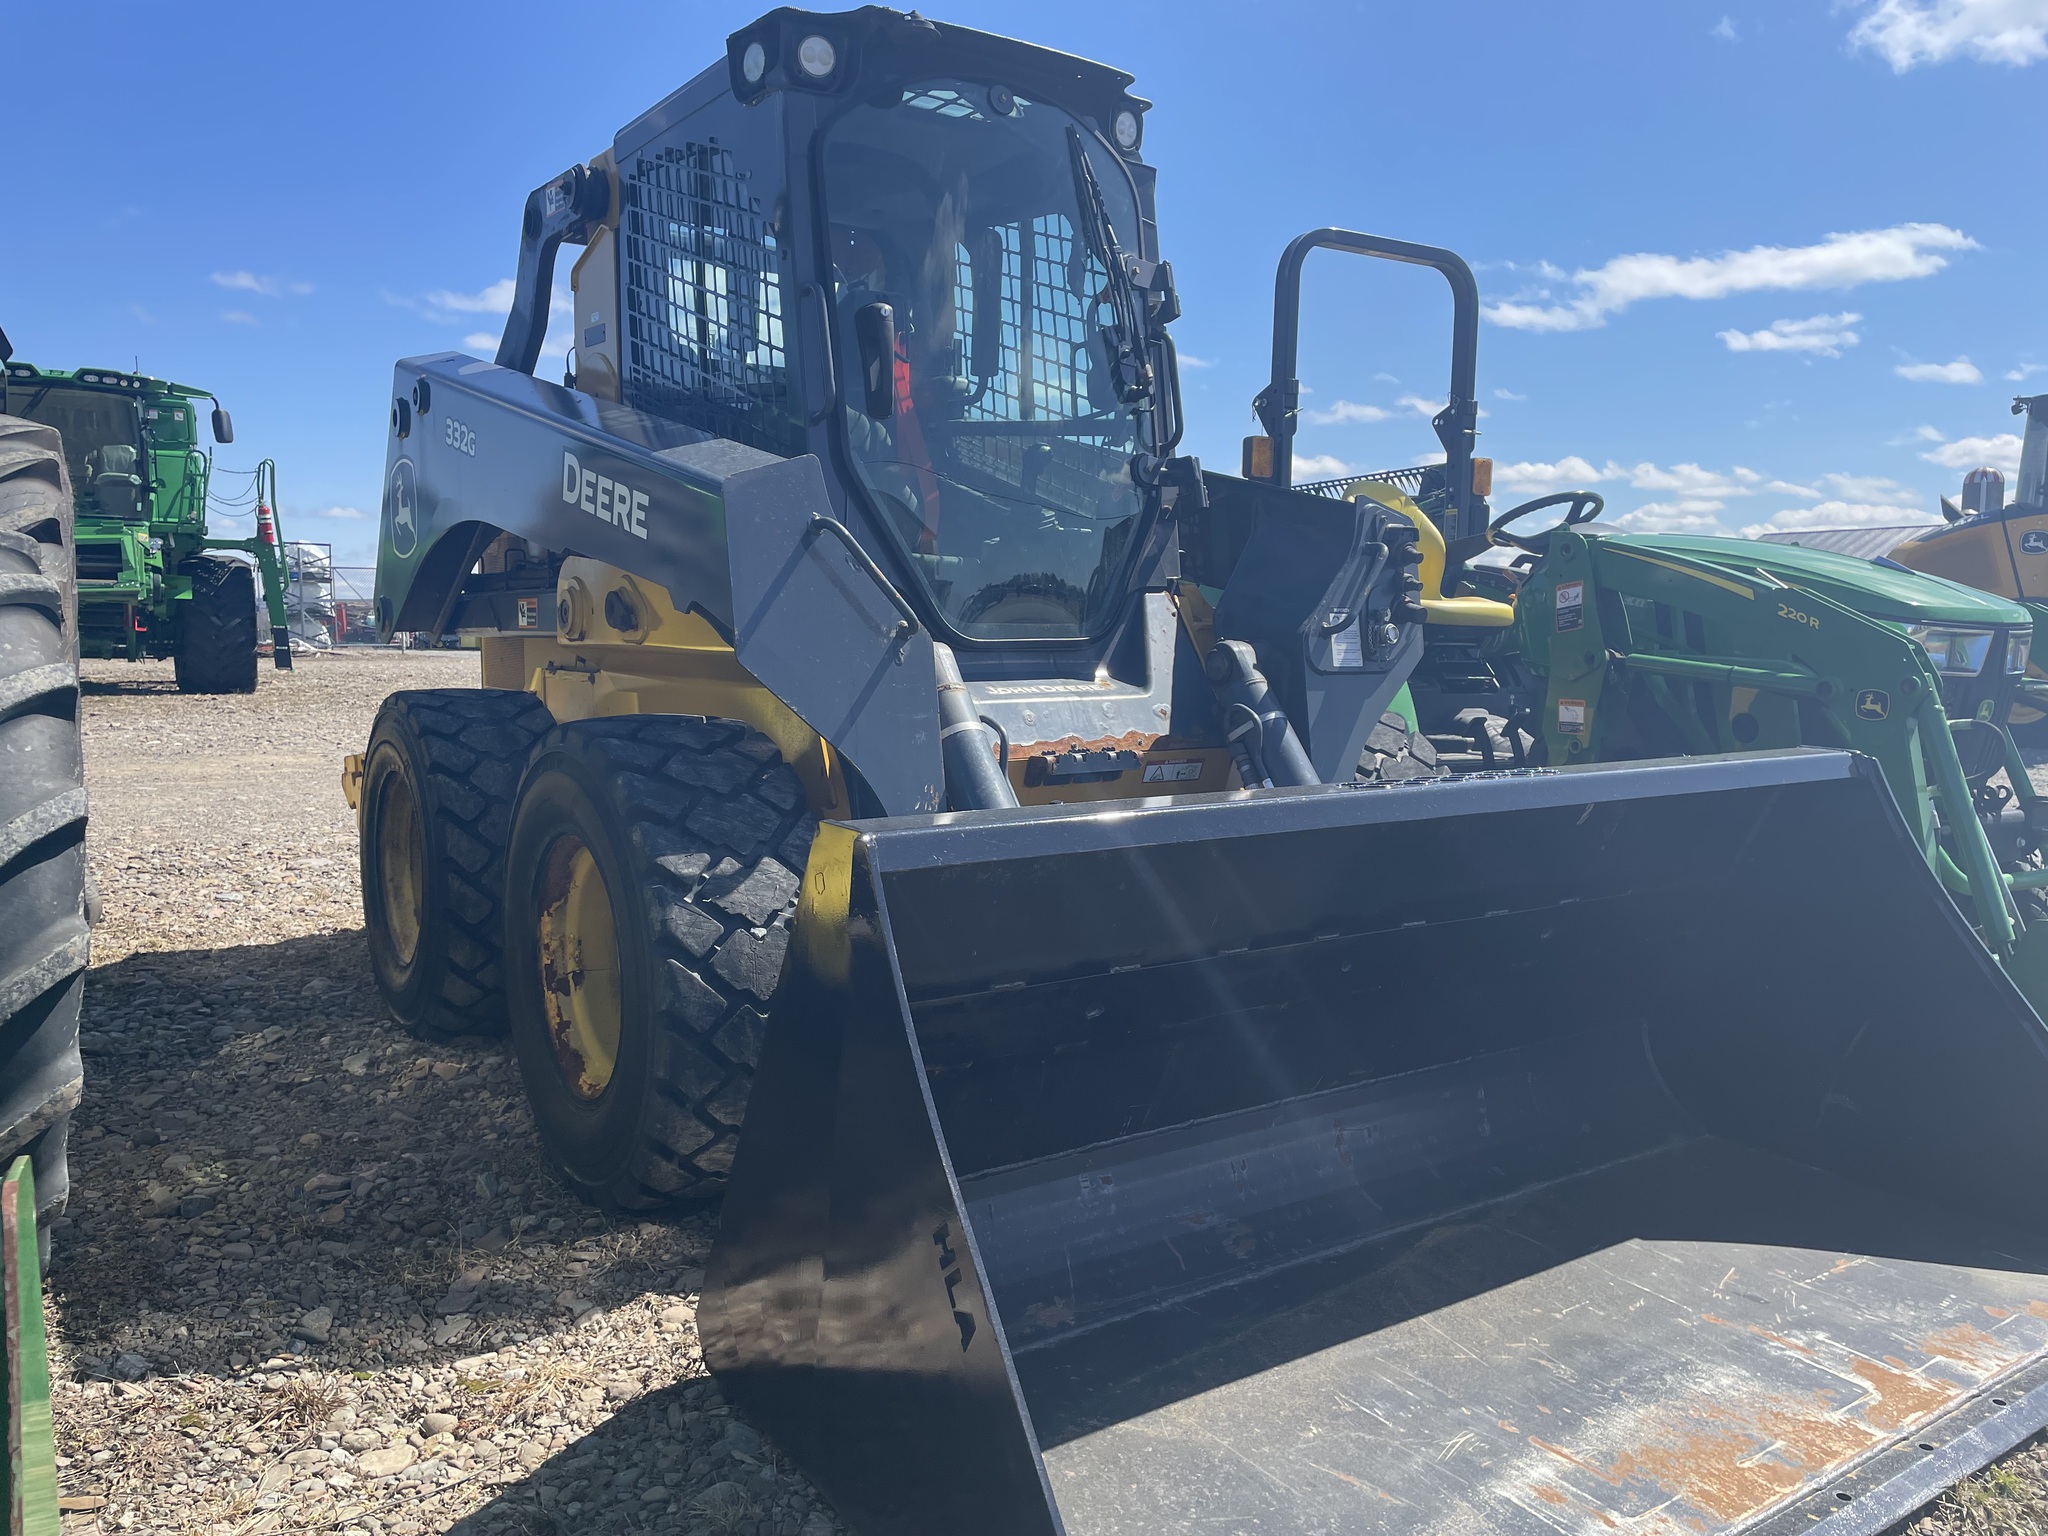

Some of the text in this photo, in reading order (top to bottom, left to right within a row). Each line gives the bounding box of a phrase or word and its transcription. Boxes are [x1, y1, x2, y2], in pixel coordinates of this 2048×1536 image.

[445, 417, 476, 457] 332G
[562, 451, 650, 541] DEERE
[985, 684, 1105, 695] JOHN DEERE
[932, 1222, 977, 1354] HLA
